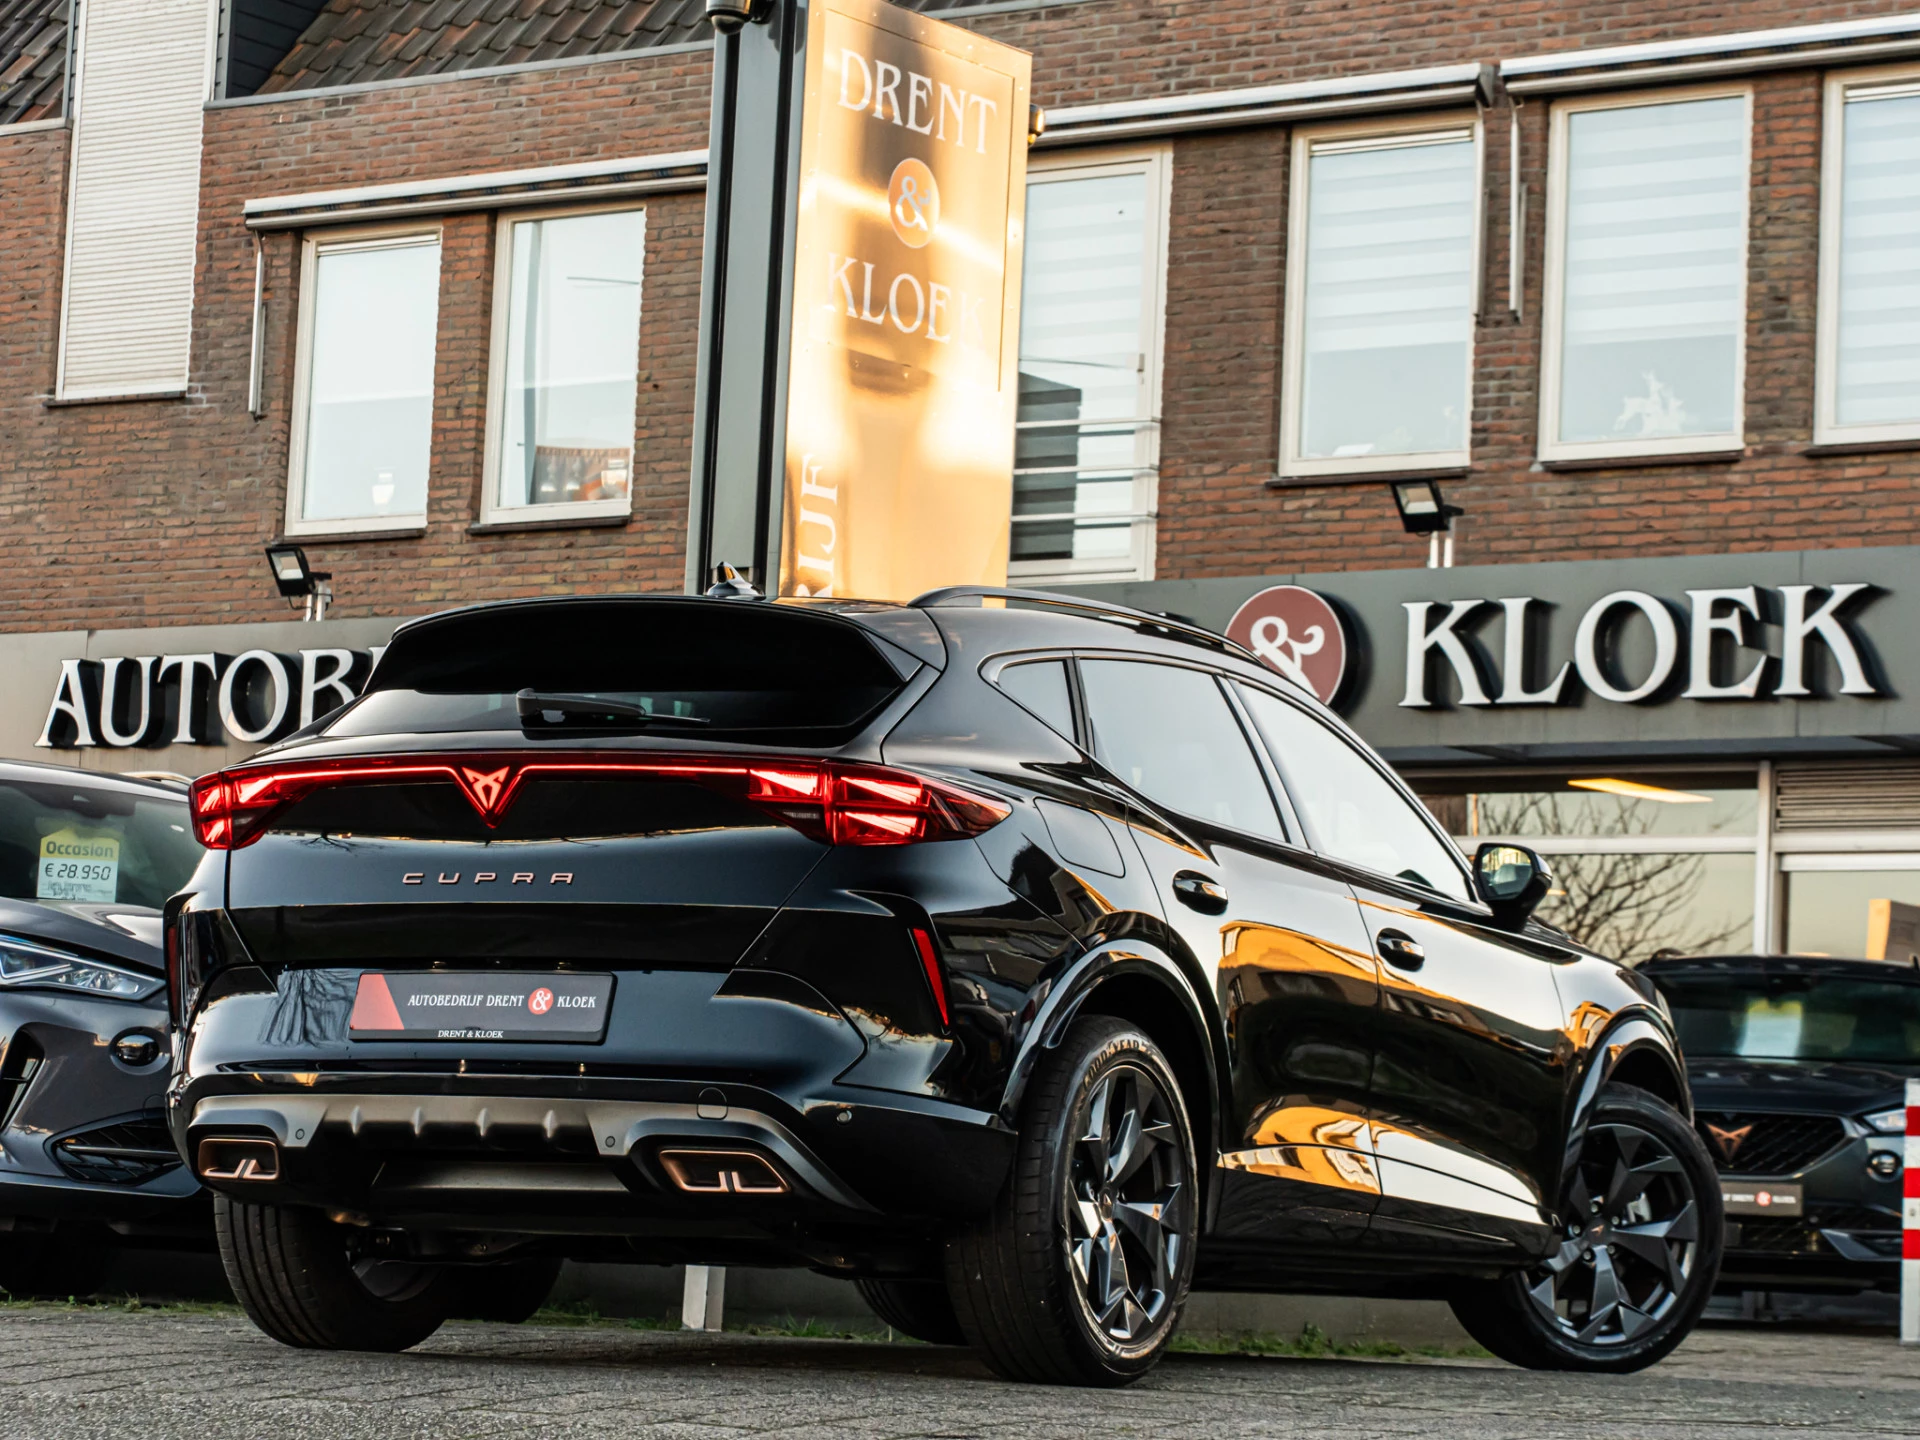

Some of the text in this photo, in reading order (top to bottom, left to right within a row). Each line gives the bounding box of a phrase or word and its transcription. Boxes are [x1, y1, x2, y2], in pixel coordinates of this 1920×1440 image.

[837, 48, 997, 154] DRENT
[895, 176, 931, 231] &
[822, 252, 988, 348] KLOEK
[34, 583, 1876, 747] AUTOB & KLOEK
[46, 841, 114, 858] Occasion
[402, 872, 575, 885] CUPRA
[407, 990, 597, 1011] AUTOBEDRIJF DRENT & KLOEK
[438, 1029, 504, 1038] DRENT & KLOEK
